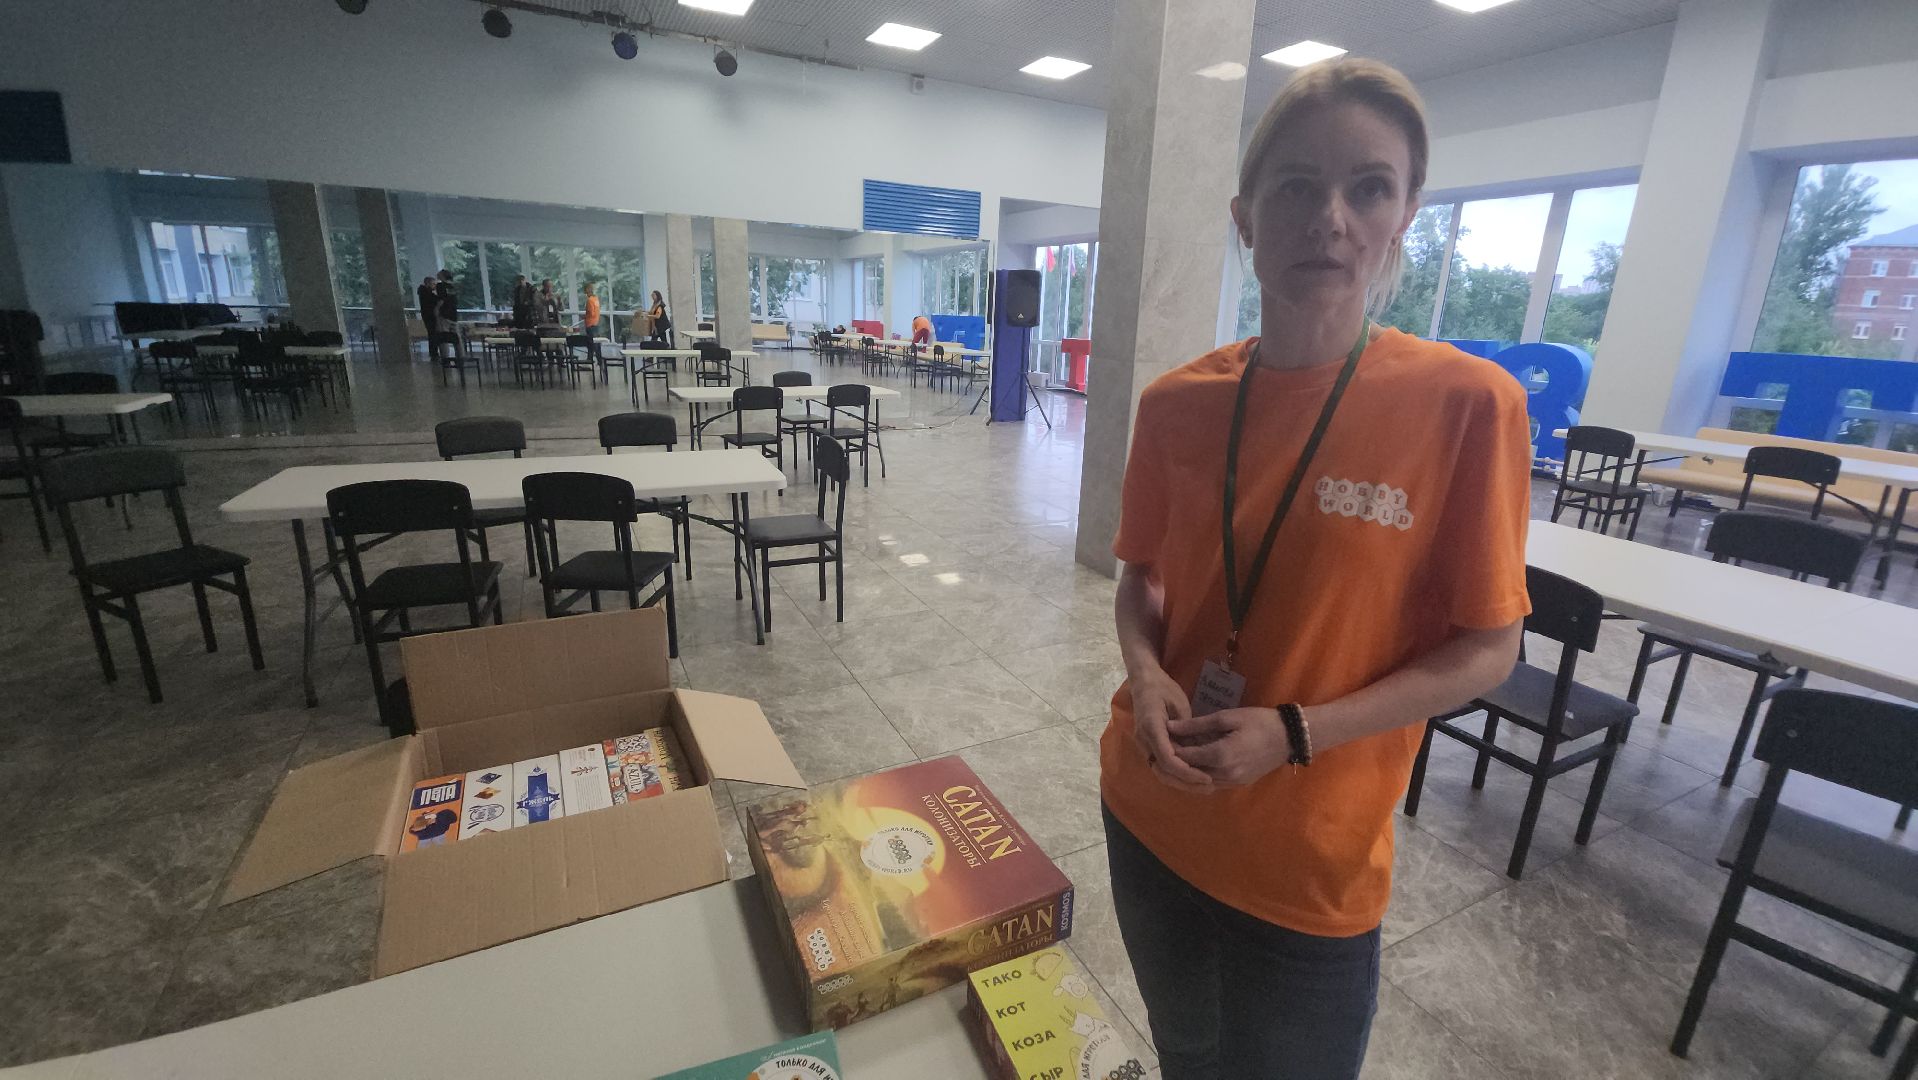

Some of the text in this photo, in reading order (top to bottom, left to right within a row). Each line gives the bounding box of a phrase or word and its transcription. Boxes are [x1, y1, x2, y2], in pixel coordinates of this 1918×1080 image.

[1318, 481, 1402, 505] HOBBY
[1323, 499, 1409, 525] WORLD
[522, 796, 554, 808] ГЖЕЛЬ
[921, 794, 982, 869] КОЛОНИЗАТОРЫ
[942, 785, 1022, 860] CATAN
[1060, 892, 1071, 931] KOSMOS
[967, 904, 1055, 956] CATAN
[816, 929, 833, 962] HOBBY
[982, 969, 1022, 988] ТАКО
[996, 1002, 1026, 1019] КОТ
[1012, 1030, 1056, 1051] КОЗА
[775, 1058, 827, 1076] ТОЛЬКО ДЛЯ
[1030, 1066, 1064, 1080] СЫР
